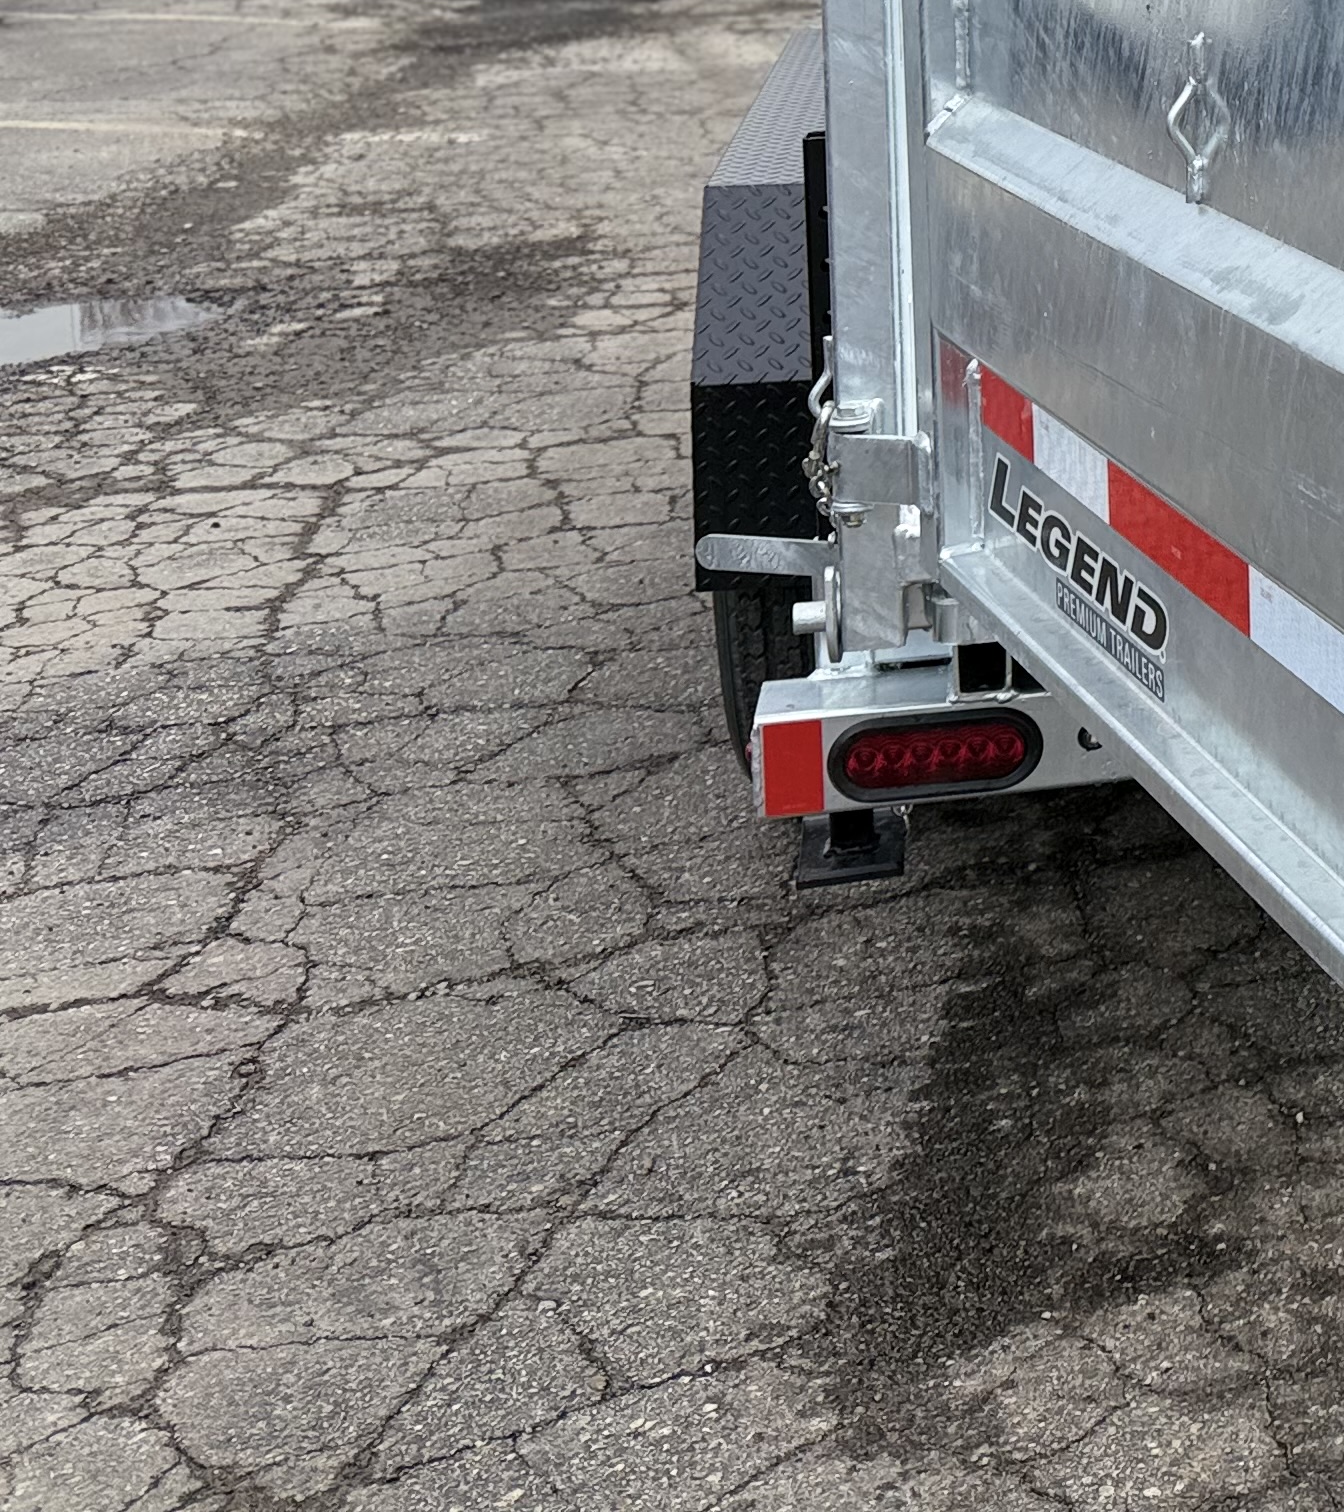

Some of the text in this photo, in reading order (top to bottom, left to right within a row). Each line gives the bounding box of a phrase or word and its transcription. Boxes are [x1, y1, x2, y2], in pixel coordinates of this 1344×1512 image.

[988, 452, 1169, 656] LEGEND
[1057, 583, 1164, 700] PREMIUM TRAILERS
